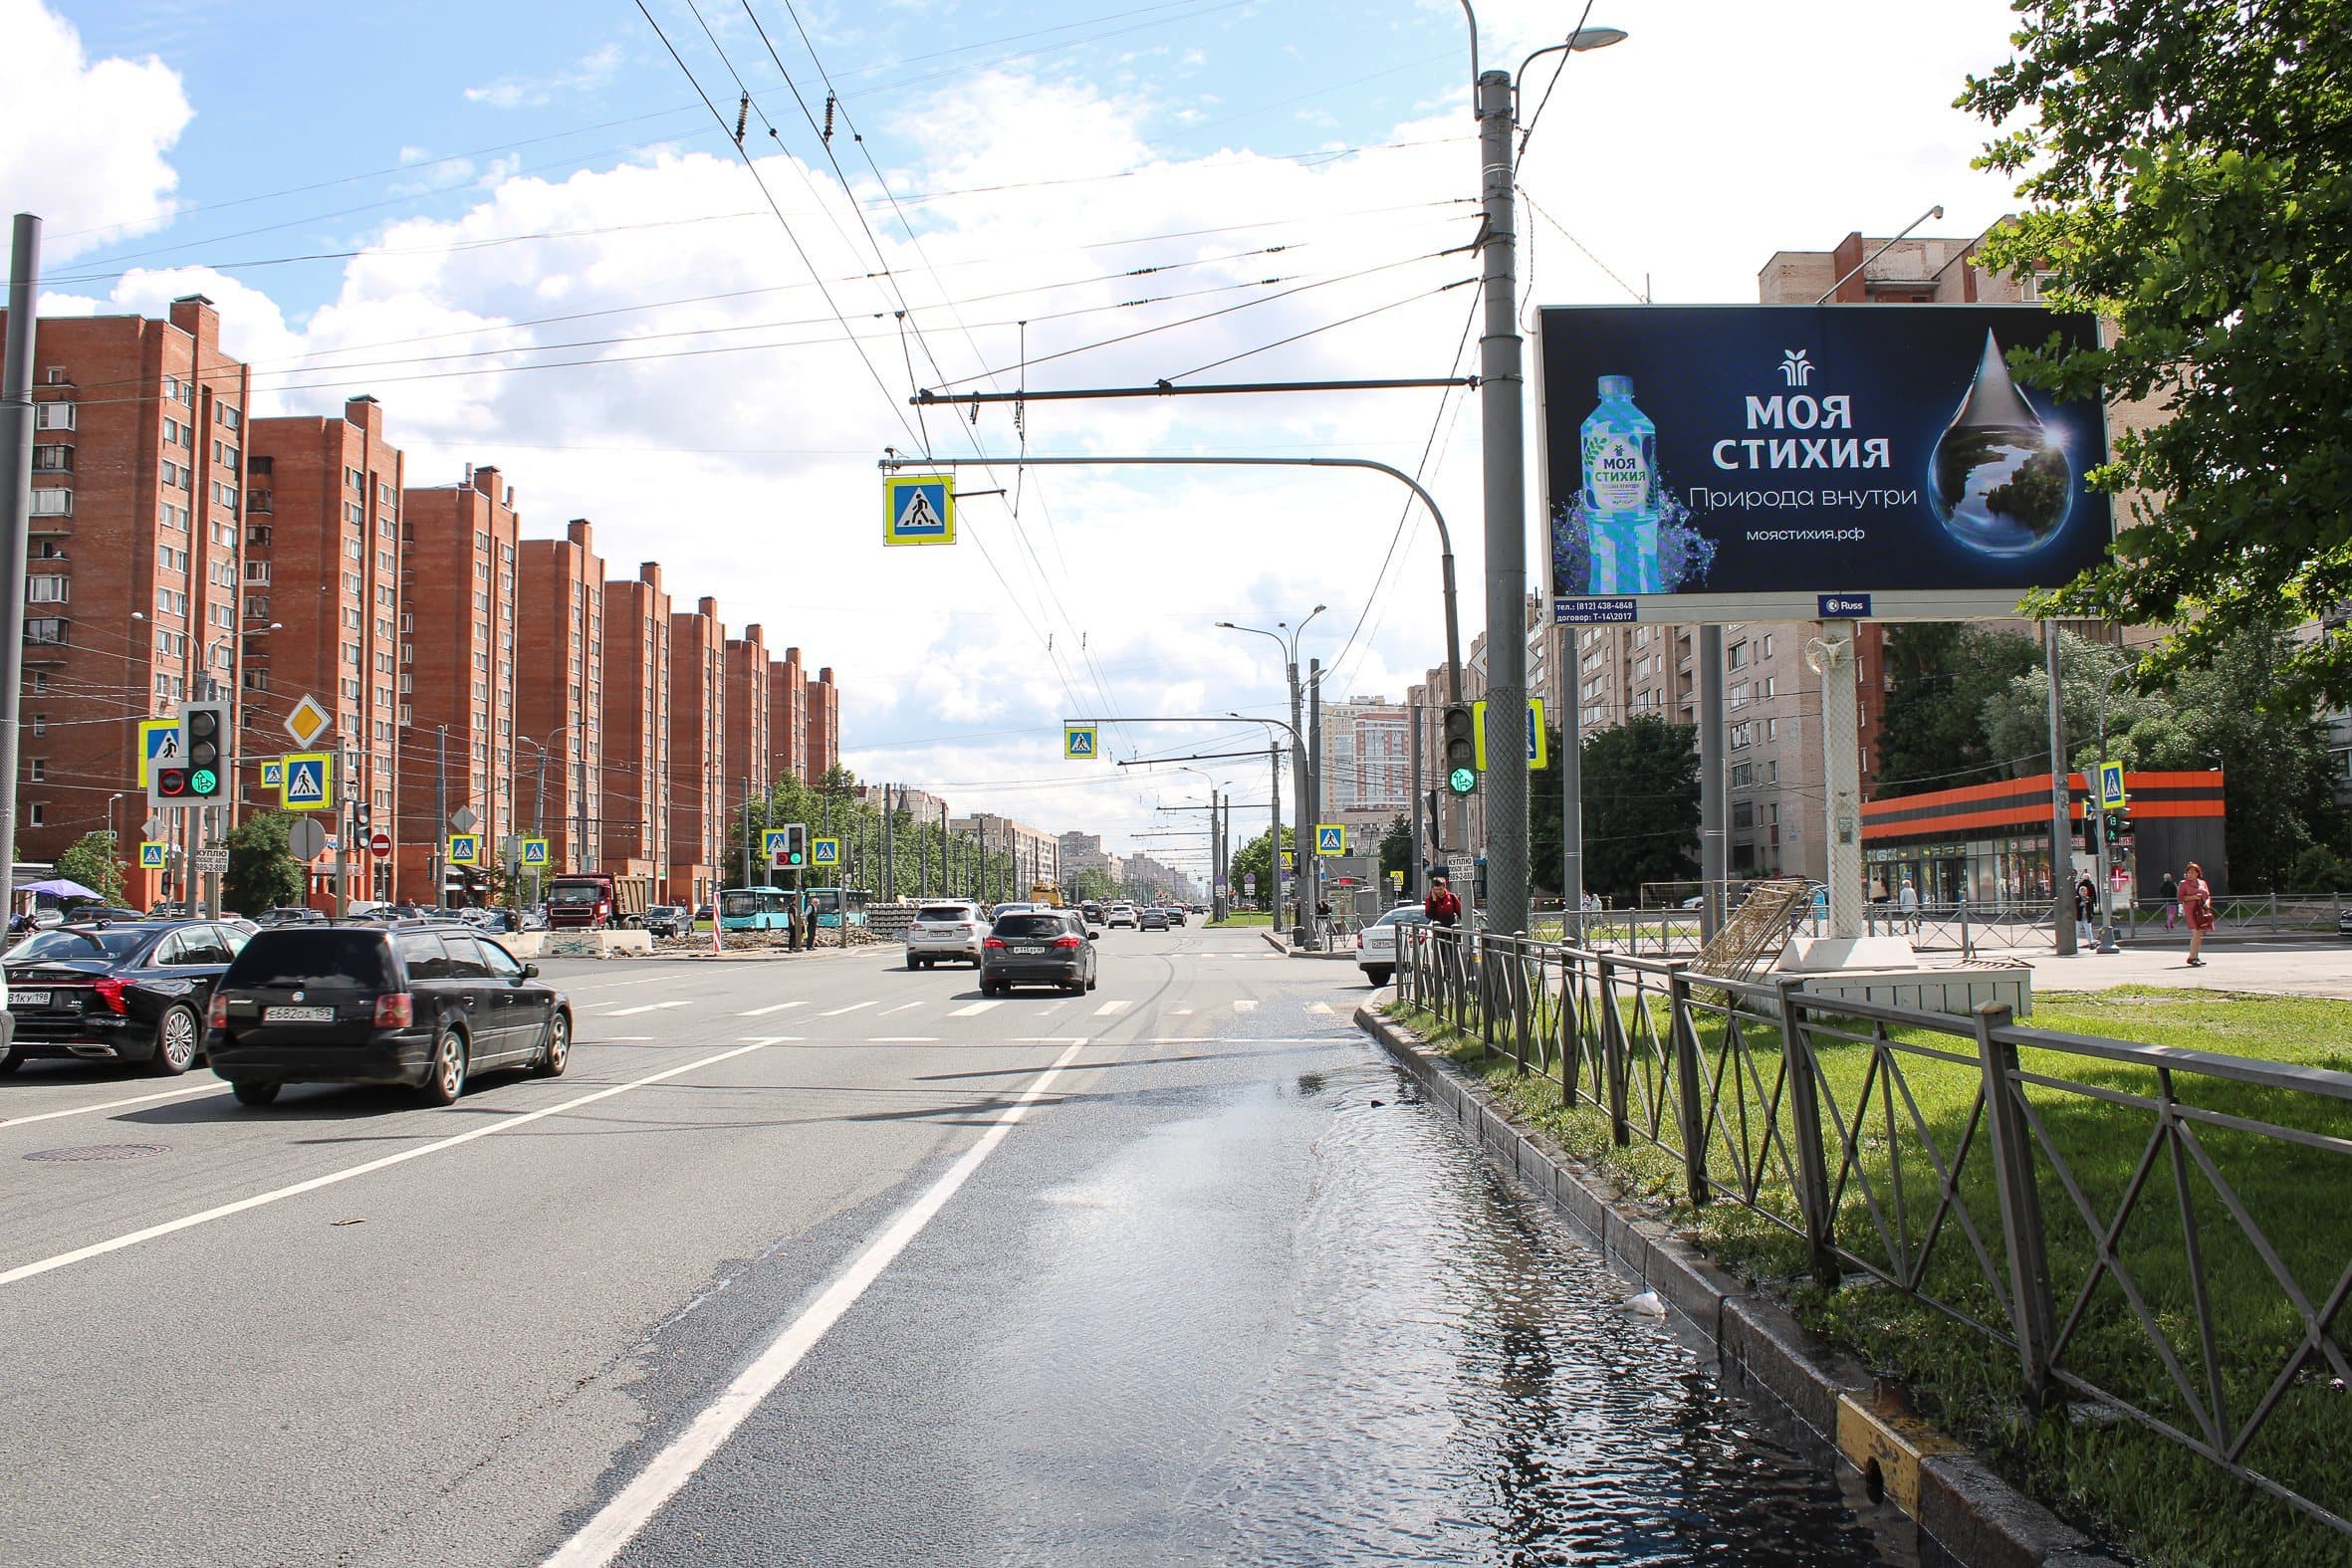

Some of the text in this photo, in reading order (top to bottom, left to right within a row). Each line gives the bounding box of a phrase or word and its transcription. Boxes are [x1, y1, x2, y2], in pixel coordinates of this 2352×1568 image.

[1745, 395, 1852, 429] МОЯ
[1712, 438, 1891, 470] СТИХИЯ
[1603, 458, 1635, 469] МОЯ
[1595, 471, 1646, 482] СТИХИЯ
[1690, 487, 1918, 510] Природа внутри
[1747, 527, 1865, 542] моястихия.рф
[1576, 601, 1596, 610] (812)
[1840, 601, 1864, 610] Russ
